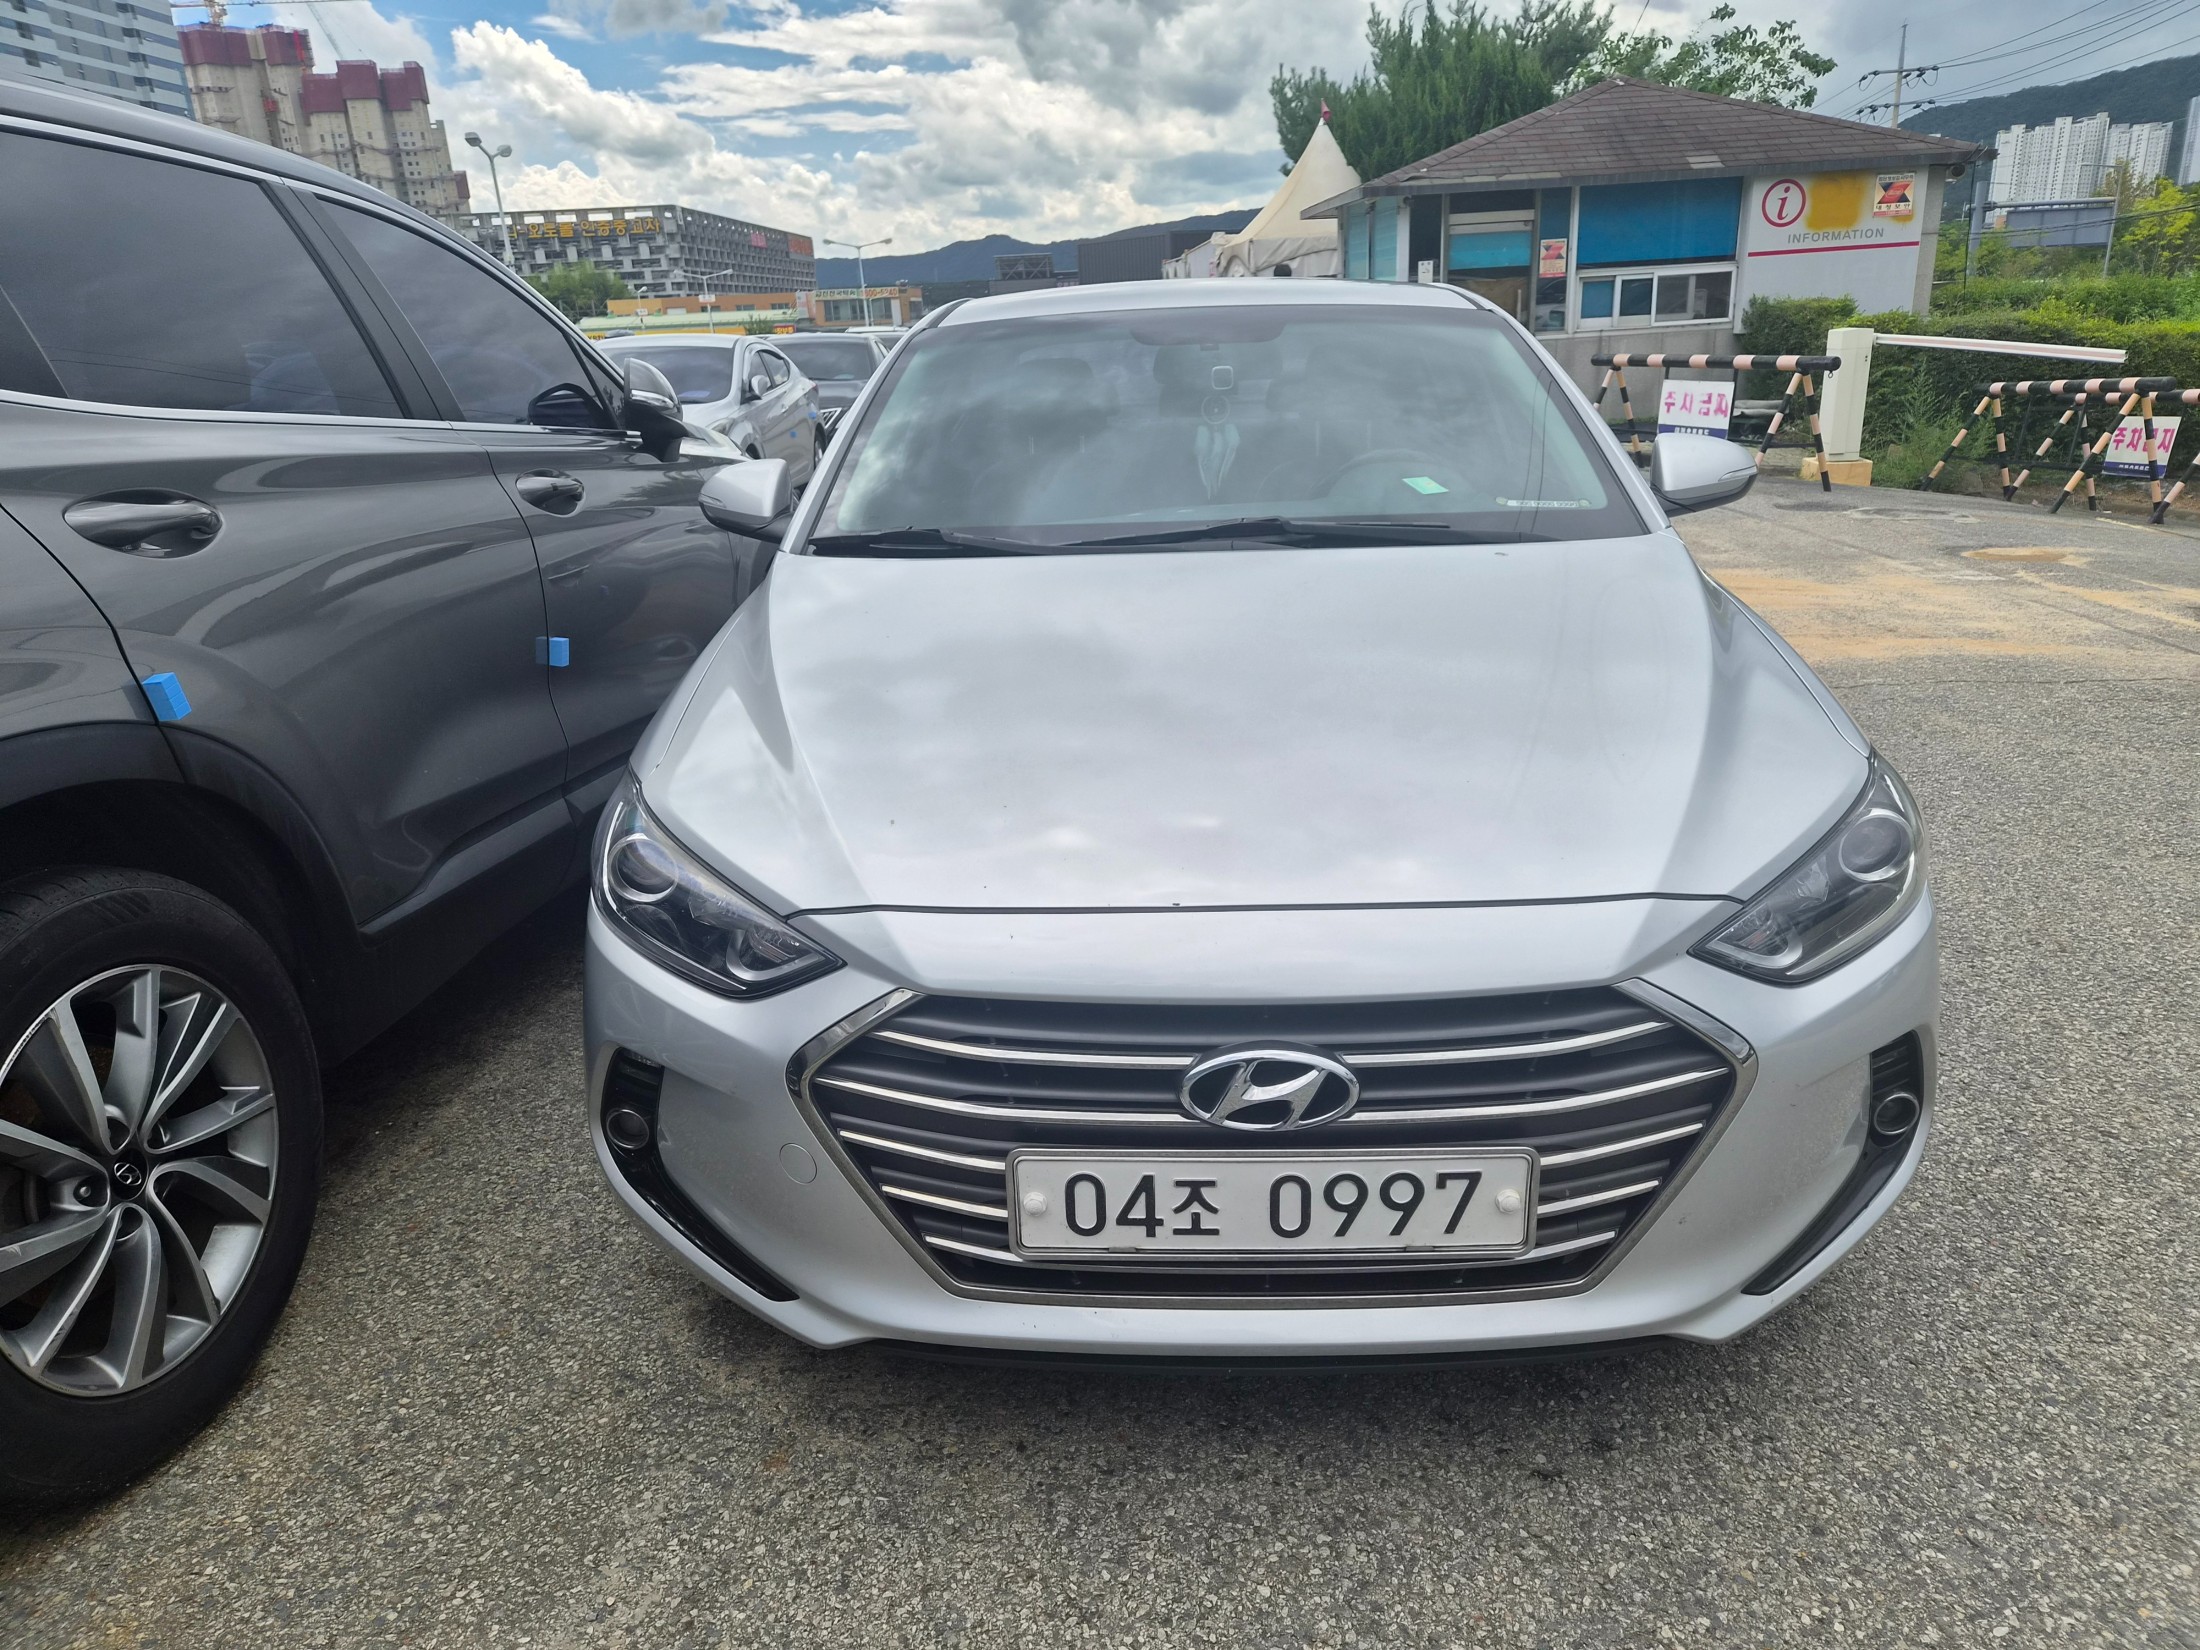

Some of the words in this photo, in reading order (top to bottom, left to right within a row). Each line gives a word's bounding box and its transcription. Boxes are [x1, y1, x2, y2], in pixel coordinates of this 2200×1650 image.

[580, 217, 660, 237] 인증중고차
[1787, 227, 1885, 244] INFORMATION
[1064, 1171, 1220, 1239] 04조
[1268, 1170, 1484, 1239] 0997
